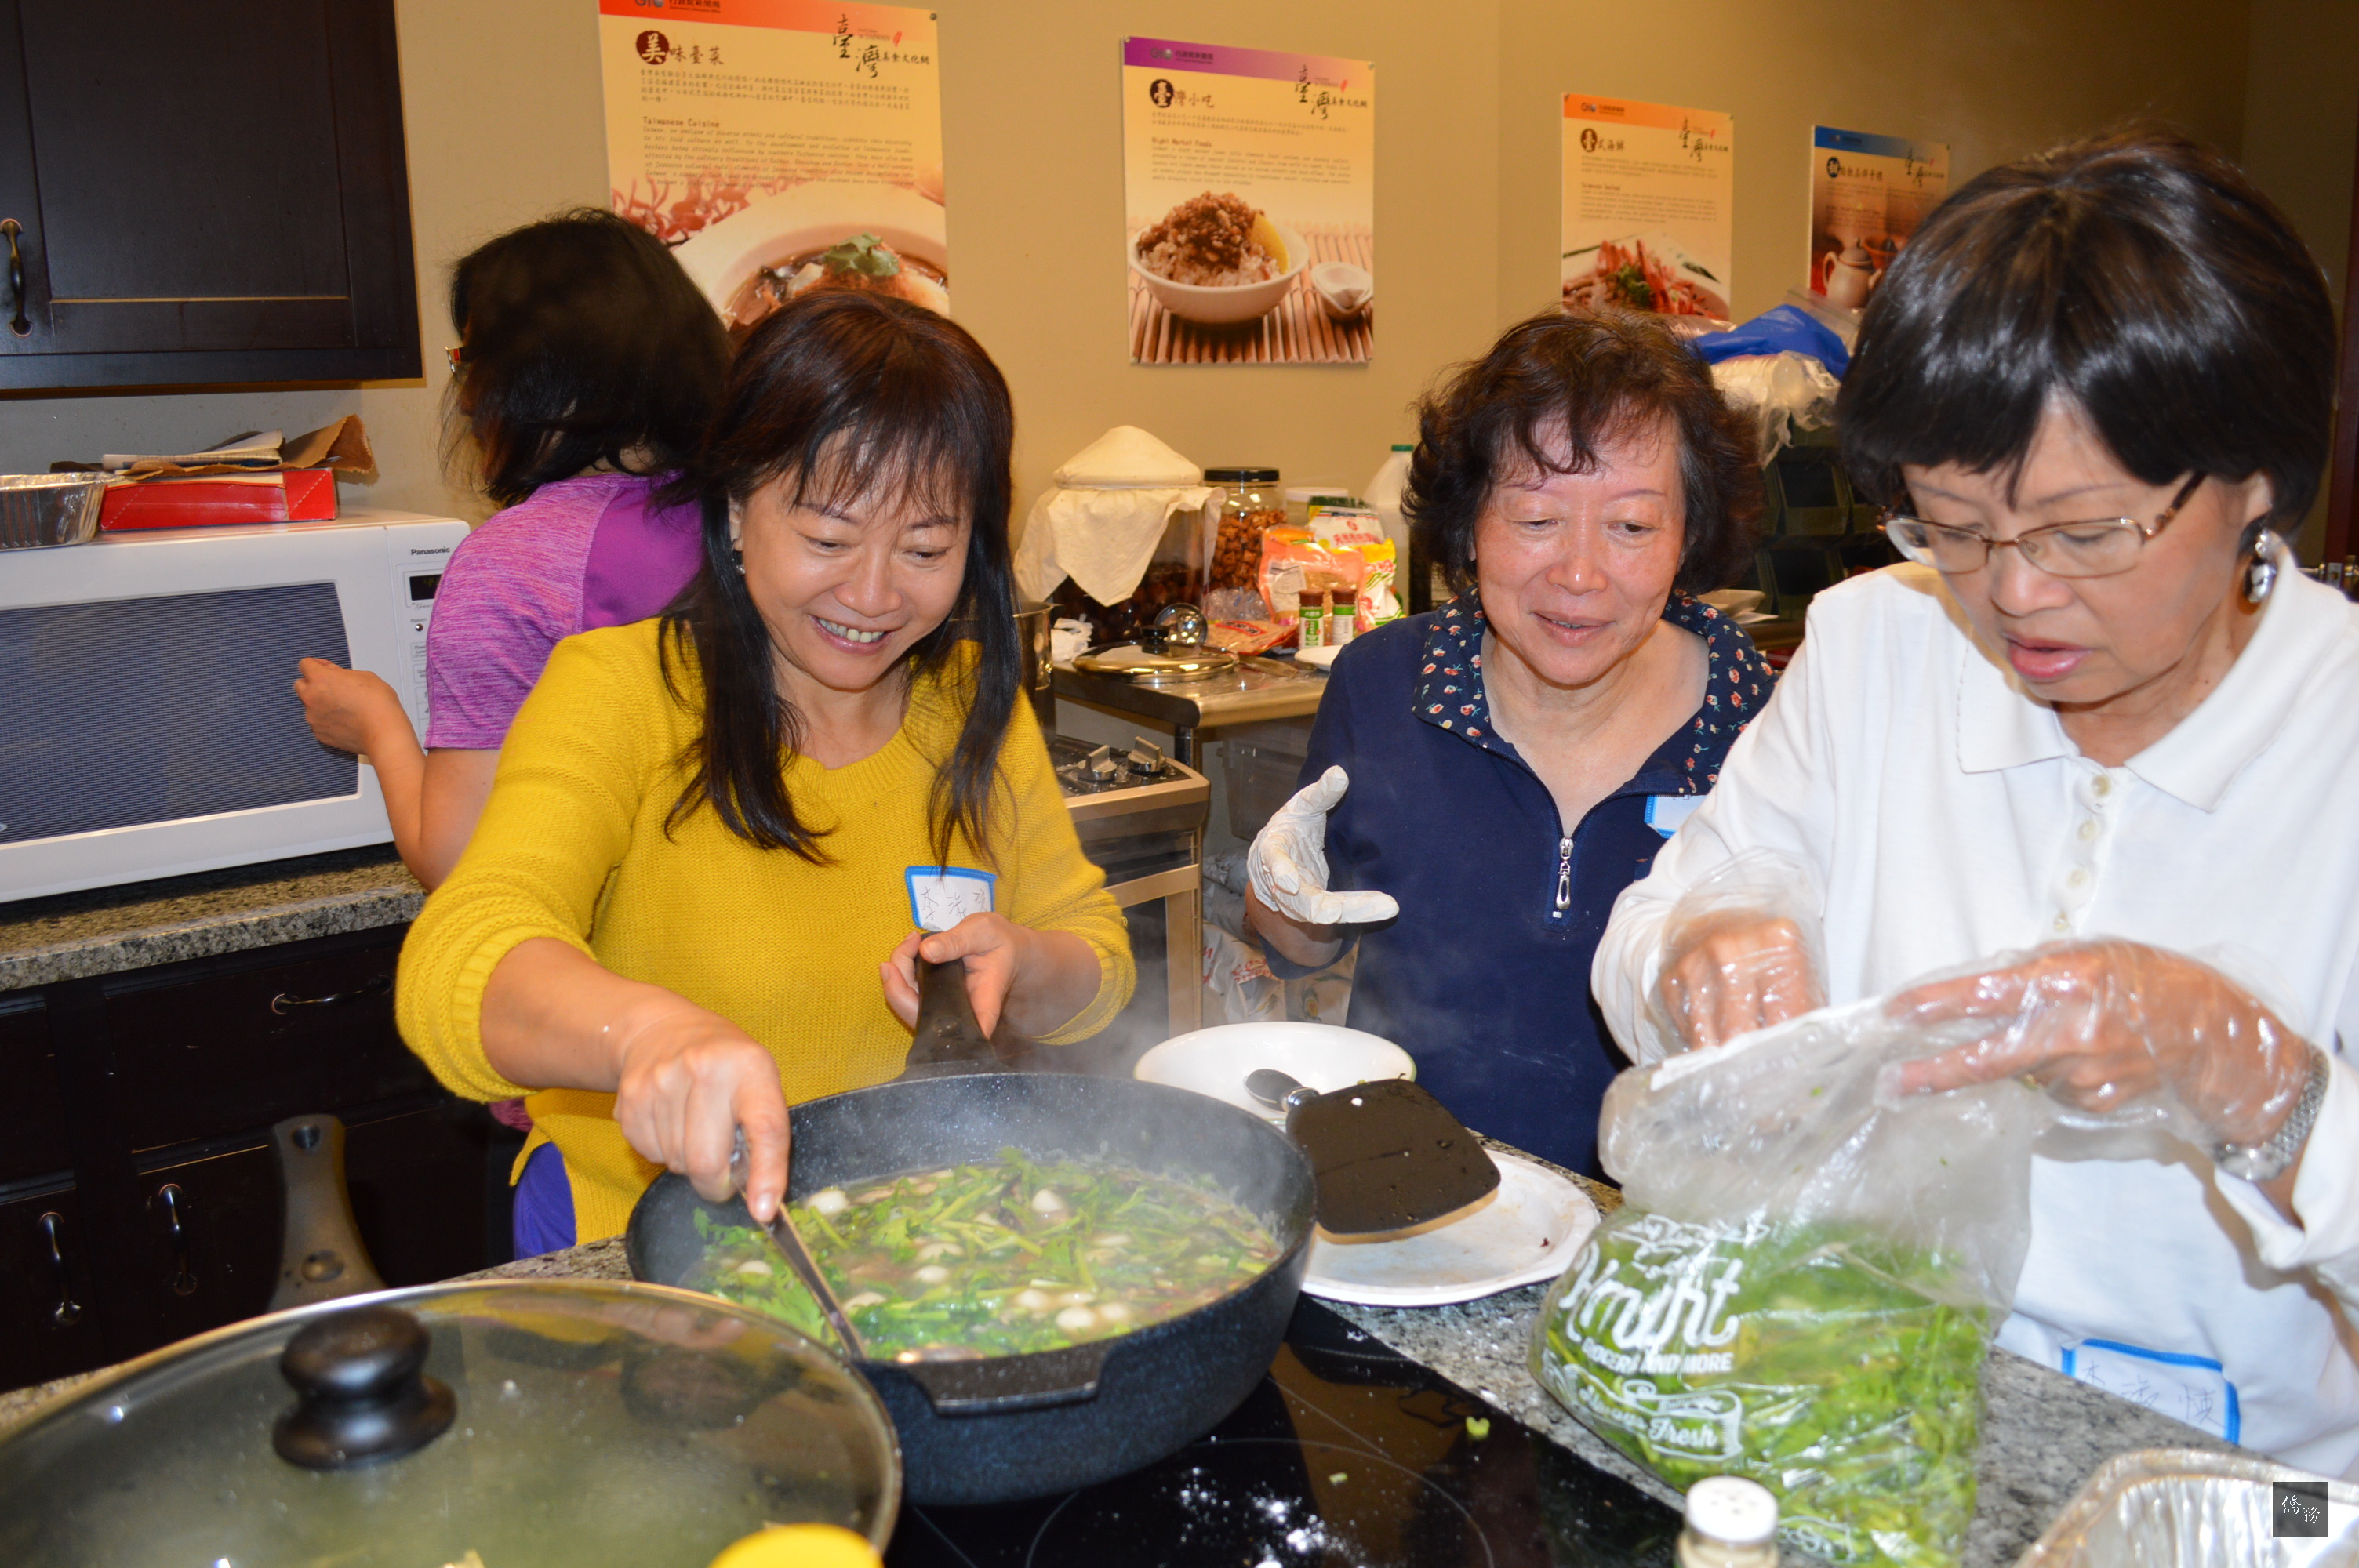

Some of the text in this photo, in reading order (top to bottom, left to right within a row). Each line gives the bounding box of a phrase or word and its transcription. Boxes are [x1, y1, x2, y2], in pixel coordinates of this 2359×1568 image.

[637, 31, 724, 65] 美味臺菜
[643, 116, 720, 128] Taiwanese Cuisine
[411, 546, 450, 555] Panasonic
[1681, 1352, 1735, 1373] MORE
[1648, 1417, 1718, 1449] Fresh
